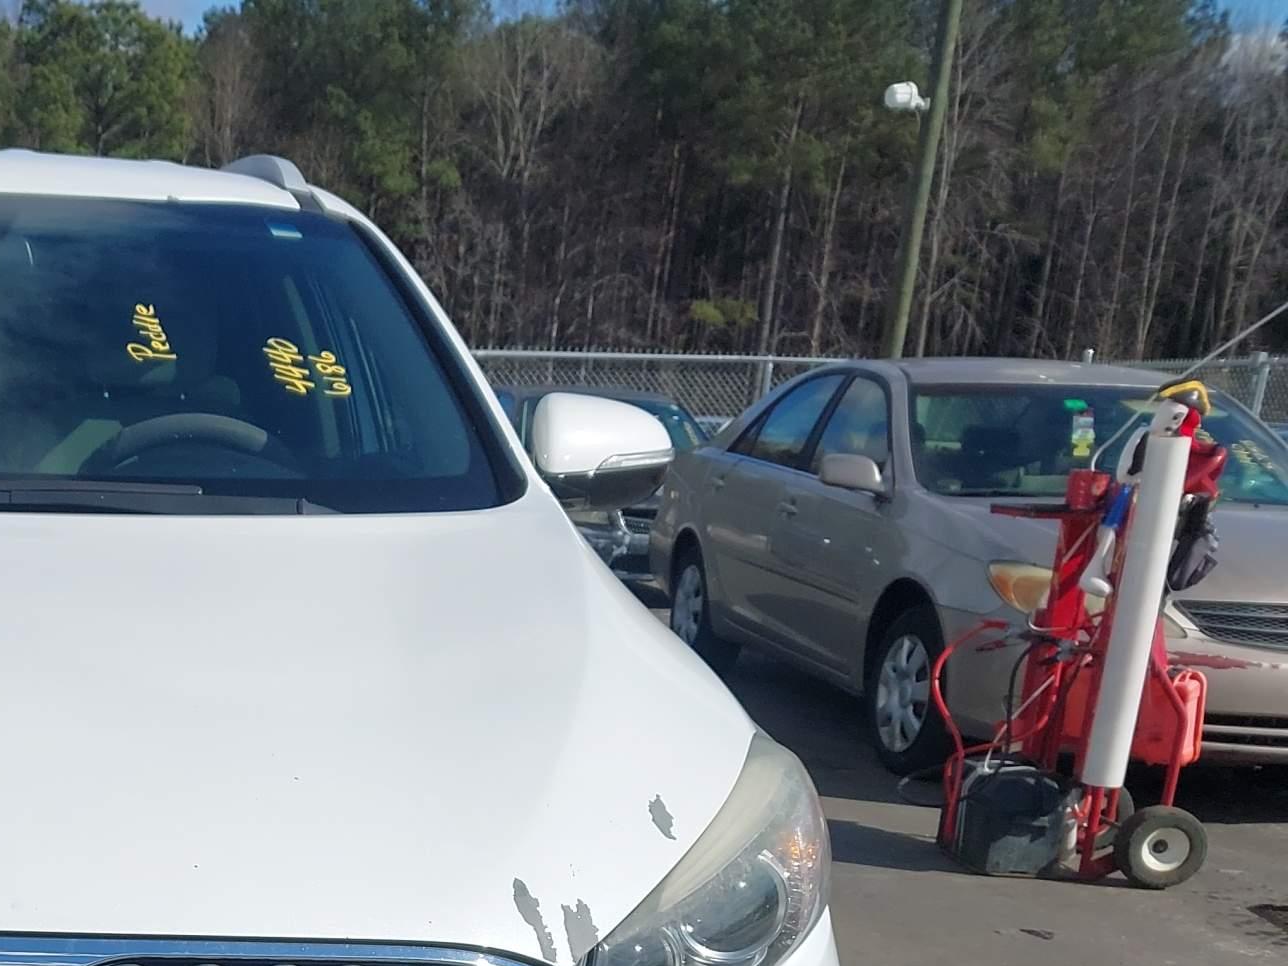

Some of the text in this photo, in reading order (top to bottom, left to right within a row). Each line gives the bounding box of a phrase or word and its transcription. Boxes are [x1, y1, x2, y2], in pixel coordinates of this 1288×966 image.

[127, 303, 177, 361] Peddle
[262, 337, 315, 395] 4440
[308, 351, 352, 396] 6186
